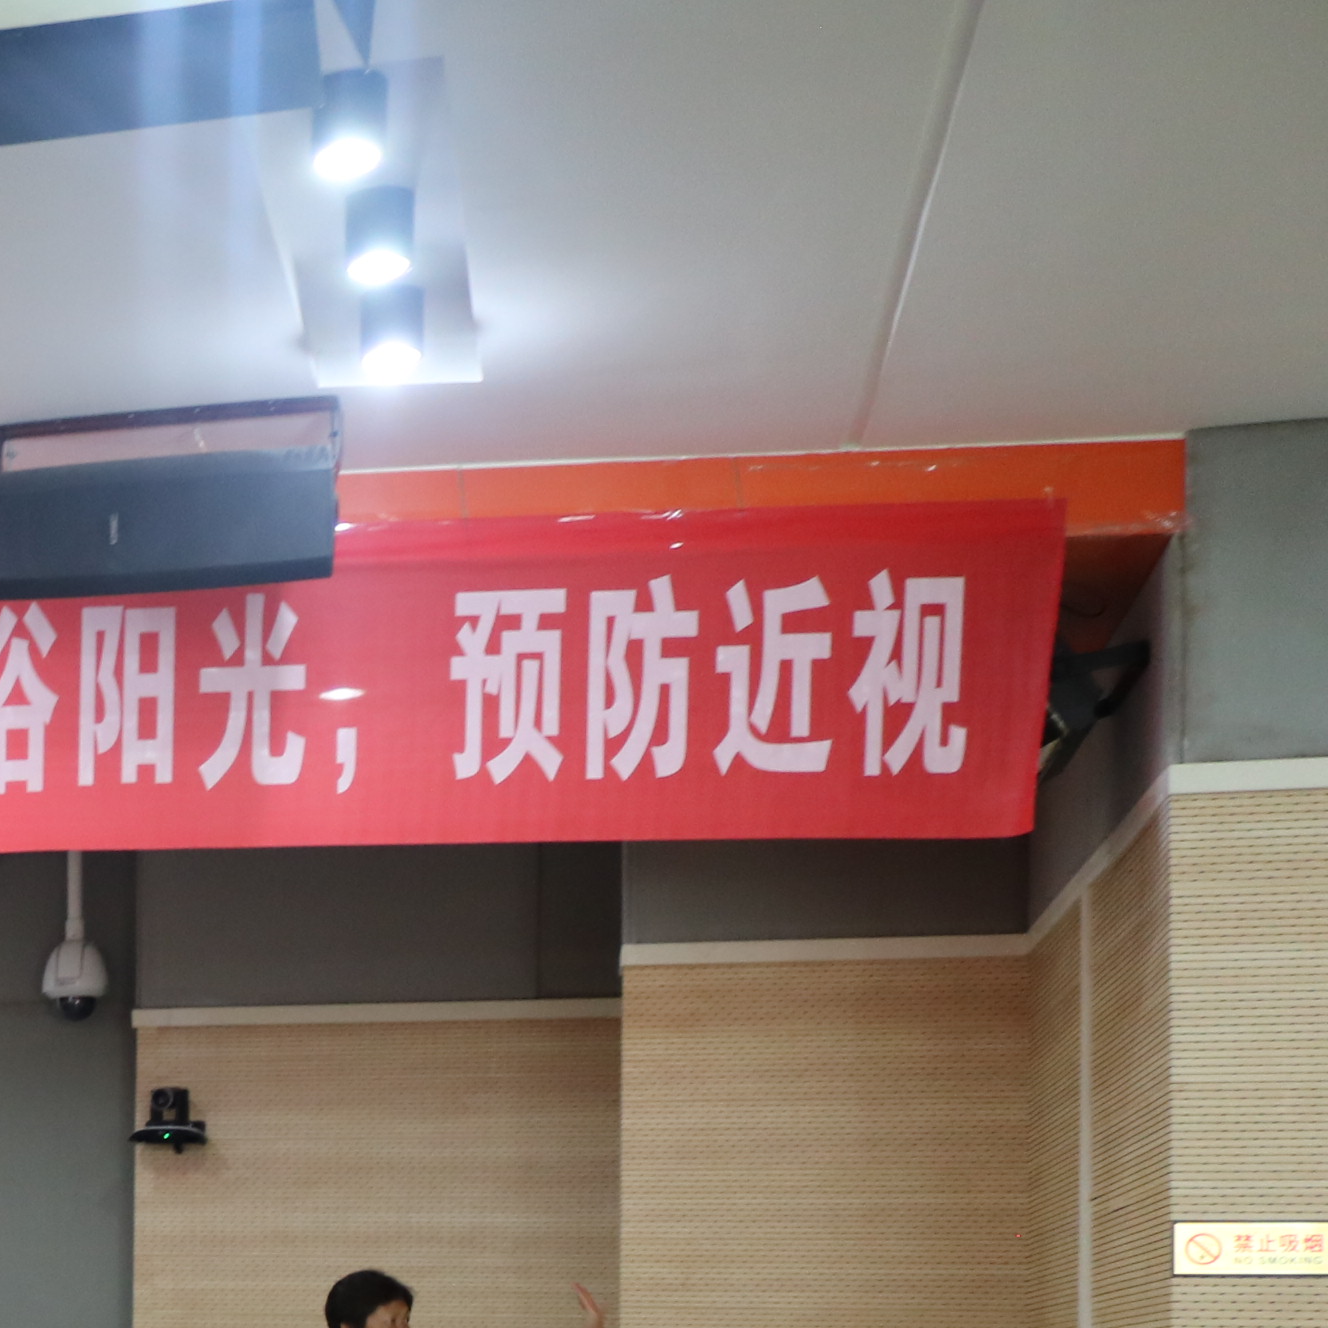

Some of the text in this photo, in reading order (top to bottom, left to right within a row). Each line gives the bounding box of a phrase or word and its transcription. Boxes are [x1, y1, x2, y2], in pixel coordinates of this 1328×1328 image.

[1233, 1233, 1324, 1253] 禁止吸烟
[1259, 1256, 1323, 1265] SMOKING
